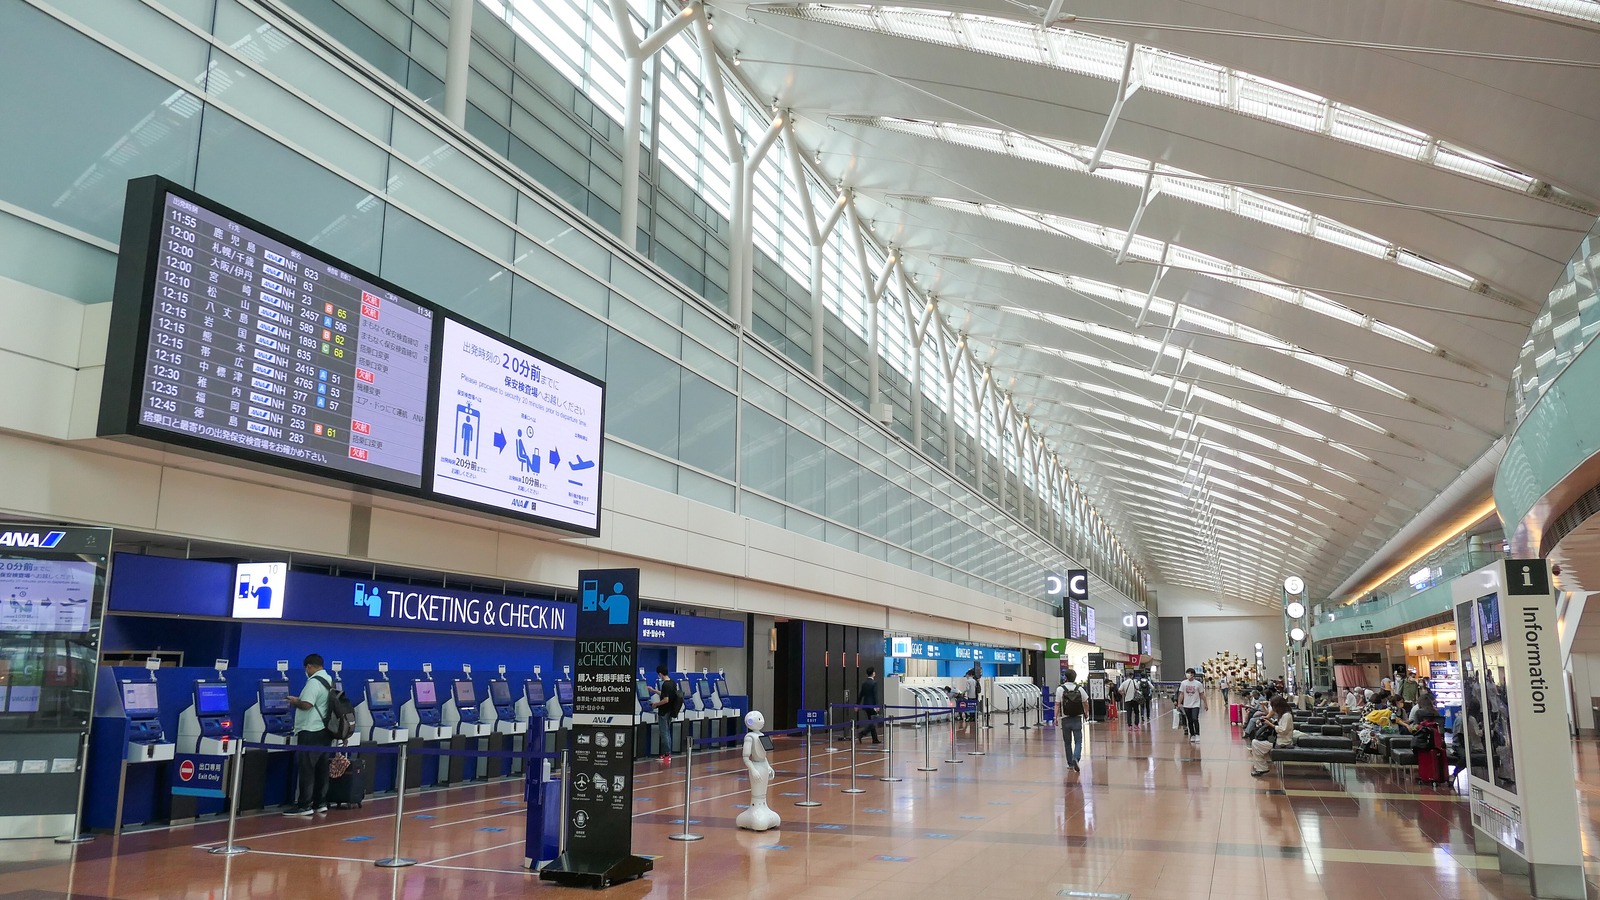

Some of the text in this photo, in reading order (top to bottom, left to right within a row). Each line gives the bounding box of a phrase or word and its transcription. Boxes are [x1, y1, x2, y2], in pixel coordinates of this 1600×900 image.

[169, 224, 195, 243] 12:00
[283, 272, 296, 285] NH
[302, 280, 313, 292] 63
[170, 209, 197, 228] 11:55
[285, 258, 298, 272] NH
[303, 266, 318, 281] 623
[165, 254, 192, 273] 12:00
[281, 299, 294, 313] NH
[300, 307, 319, 323] 2457
[334, 320, 347, 333] 506
[167, 239, 193, 258] 12:00
[282, 286, 295, 299] NH
[301, 293, 312, 306] 23
[336, 307, 346, 320] 65
[160, 300, 187, 318] 12:15
[277, 341, 290, 354] NH
[296, 347, 311, 361] 635
[161, 285, 188, 303] 12:15
[278, 327, 291, 340] NH
[297, 334, 317, 349] 1893
[333, 347, 343, 359] 68
[163, 269, 190, 288] 12:10
[279, 313, 293, 326] NH
[298, 320, 313, 334] 589
[334, 333, 344, 346] 62
[417, 306, 431, 318] 11:34
[156, 332, 183, 349] 12:15
[274, 369, 287, 382] NH
[293, 375, 313, 390] 4765
[330, 386, 340, 398] 53
[158, 316, 185, 334] 12:15
[275, 355, 289, 368] NH
[295, 361, 314, 376] 2415
[331, 373, 341, 385] 51
[152, 363, 180, 380] 12:30
[271, 398, 285, 410] NH
[291, 403, 306, 416] 573
[154, 347, 181, 365] 12:15
[273, 383, 286, 396] NH
[292, 389, 307, 402] 377
[329, 400, 339, 412] 57
[461, 372, 477, 385] Please
[504, 374, 585, 417] 保安検査場へお越しください
[148, 395, 176, 412] 12:45
[269, 426, 282, 438] NH
[288, 431, 304, 444] 283
[150, 379, 178, 396] 12:35
[270, 412, 283, 424] NH
[290, 417, 305, 430] 253
[326, 427, 337, 438] 61
[0, 532, 39, 547] ANA
[269, 564, 278, 574] 10
[1070, 576, 1085, 594] C
[1291, 580, 1298, 591] 5
[387, 590, 564, 630] TICKETING & CHECK IN
[1137, 615, 1148, 627] D
[579, 642, 632, 653] TICKETING
[620, 655, 631, 666] IN
[1051, 642, 1059, 654] C
[1522, 607, 1548, 714] Information
[578, 674, 631, 682] 購入・搭乗手続き
[199, 763, 221, 771] 出口専用
